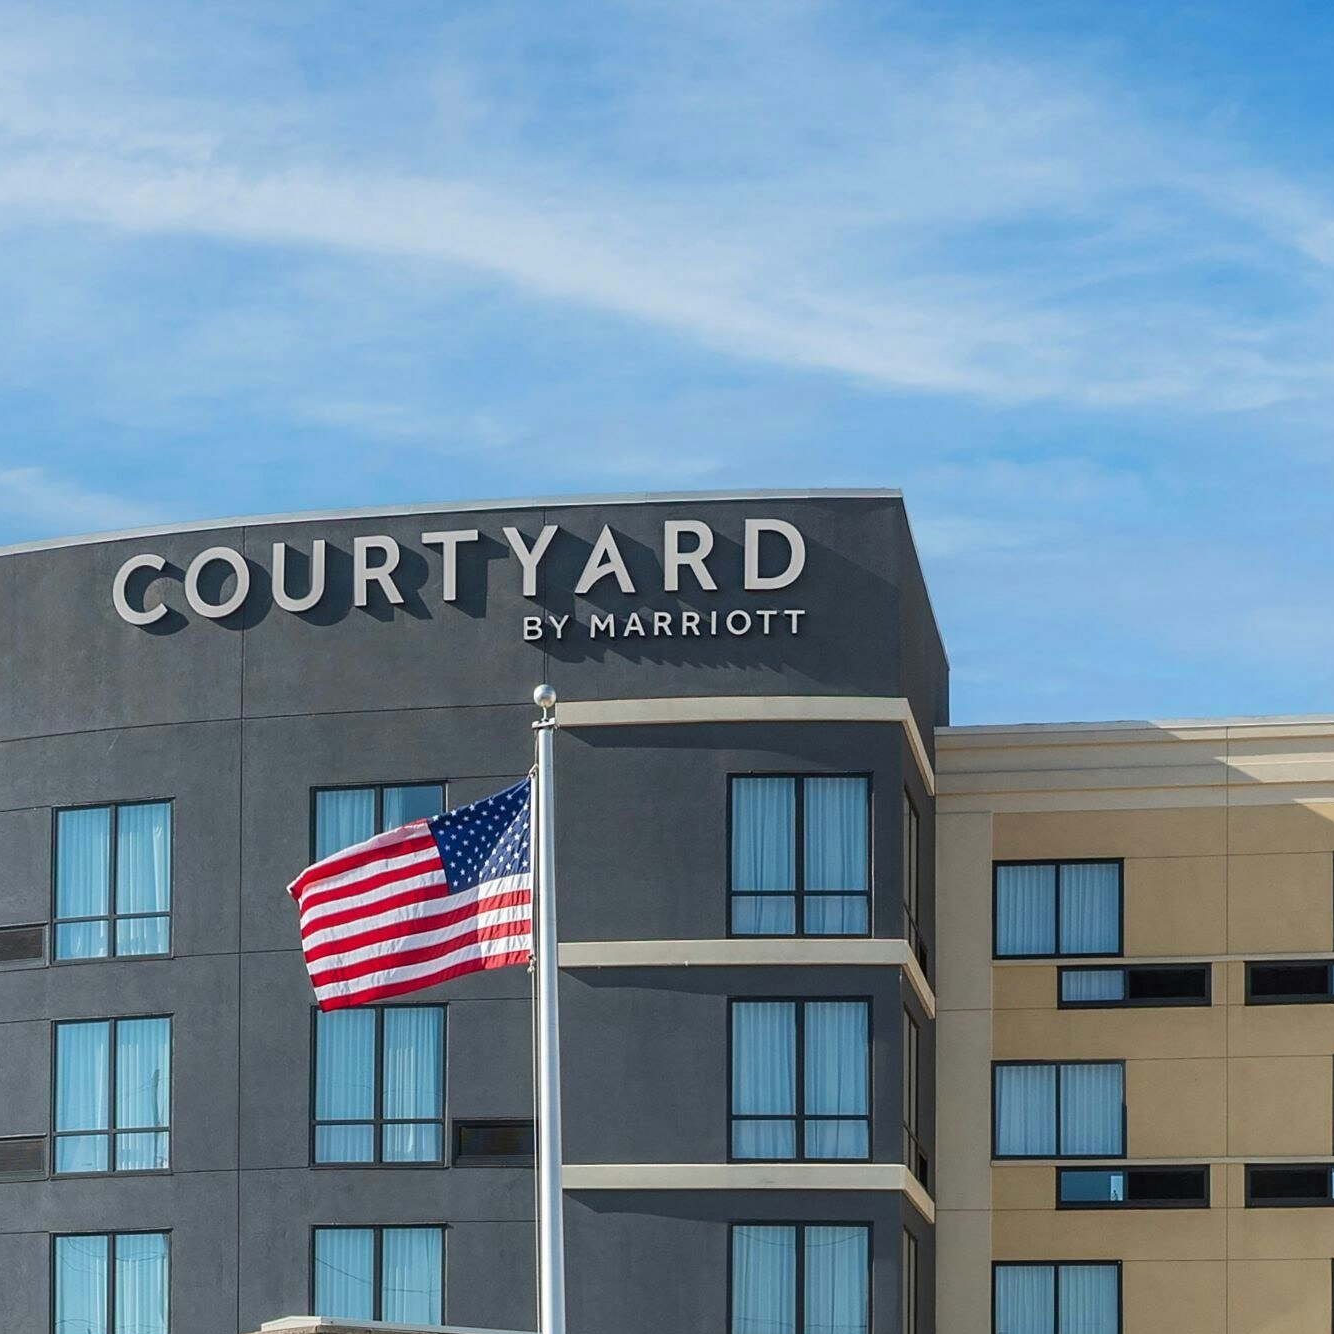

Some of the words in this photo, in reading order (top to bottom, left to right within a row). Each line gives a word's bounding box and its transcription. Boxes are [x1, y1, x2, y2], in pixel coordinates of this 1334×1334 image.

[112, 518, 806, 626] COURTYARD
[523, 614, 570, 641] BY
[589, 609, 806, 639] MARRIOTT
